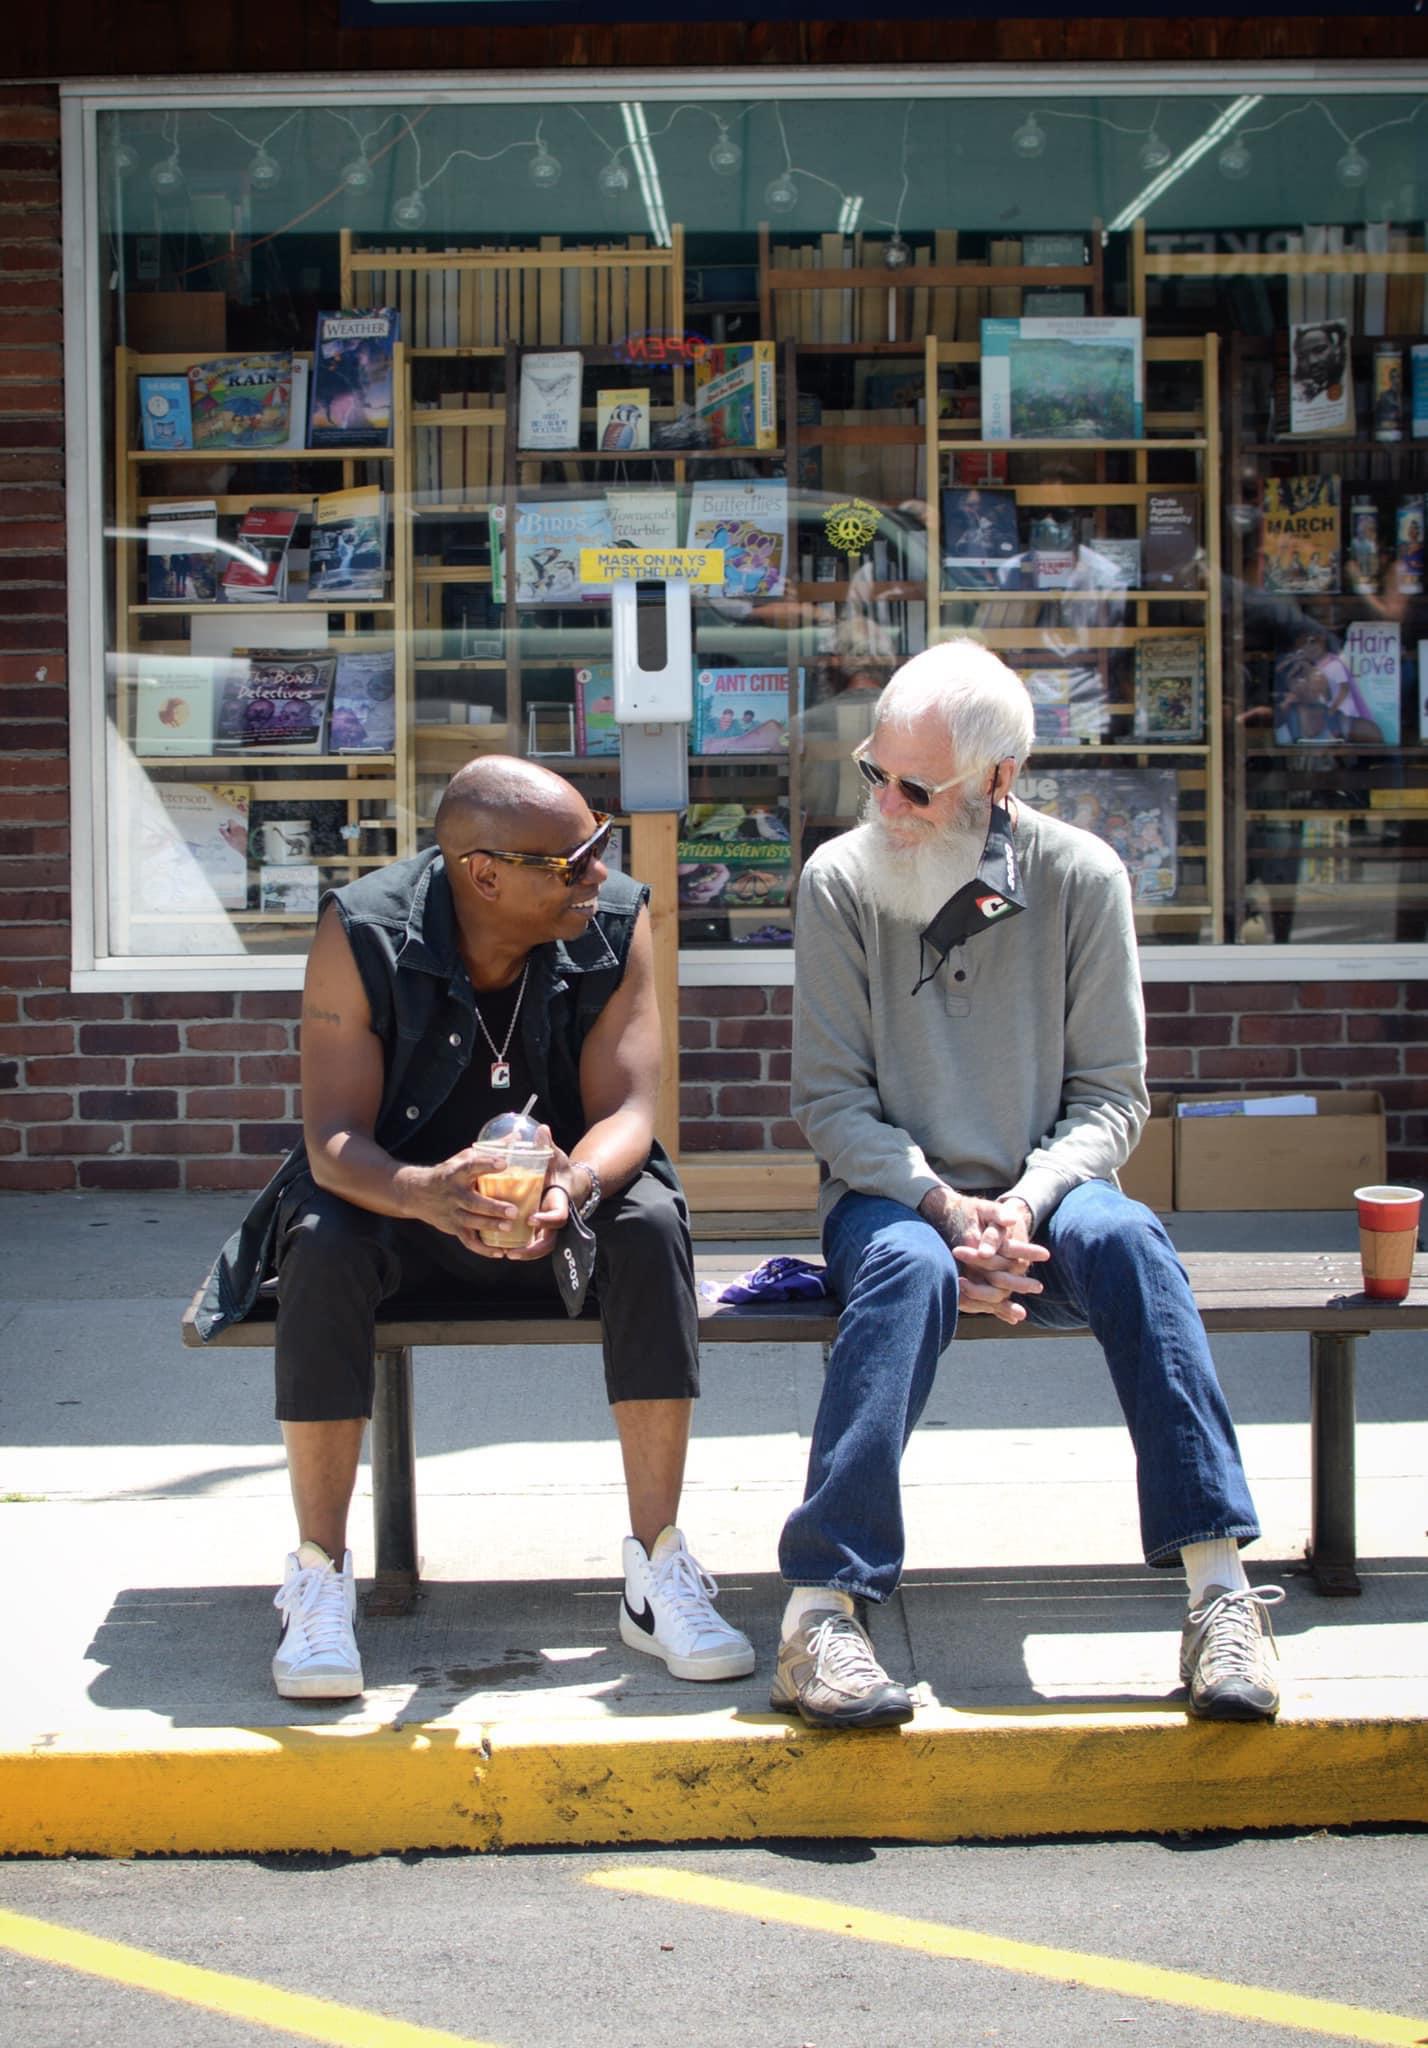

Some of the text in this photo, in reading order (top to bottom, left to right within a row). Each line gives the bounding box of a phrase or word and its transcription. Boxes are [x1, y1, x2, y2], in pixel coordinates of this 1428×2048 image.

[326, 322, 386, 337] WEATHER
[228, 372, 278, 388] RAIN
[703, 495, 783, 513] Butterflies
[609, 508, 678, 522] Townsend's
[1150, 515, 1192, 525] Humanity
[519, 511, 587, 536] BIRDS
[616, 524, 670, 537] Warbler
[1266, 516, 1334, 534] MARCH
[598, 554, 706, 566] MASK ON IN YS
[604, 567, 699, 578] IT'S THE LAW
[1351, 629, 1397, 655] Hair
[1350, 654, 1396, 679] Love
[715, 672, 792, 692] ANT CITIE
[237, 686, 314, 700] Detectives
[563, 1247, 580, 1291] 2020
